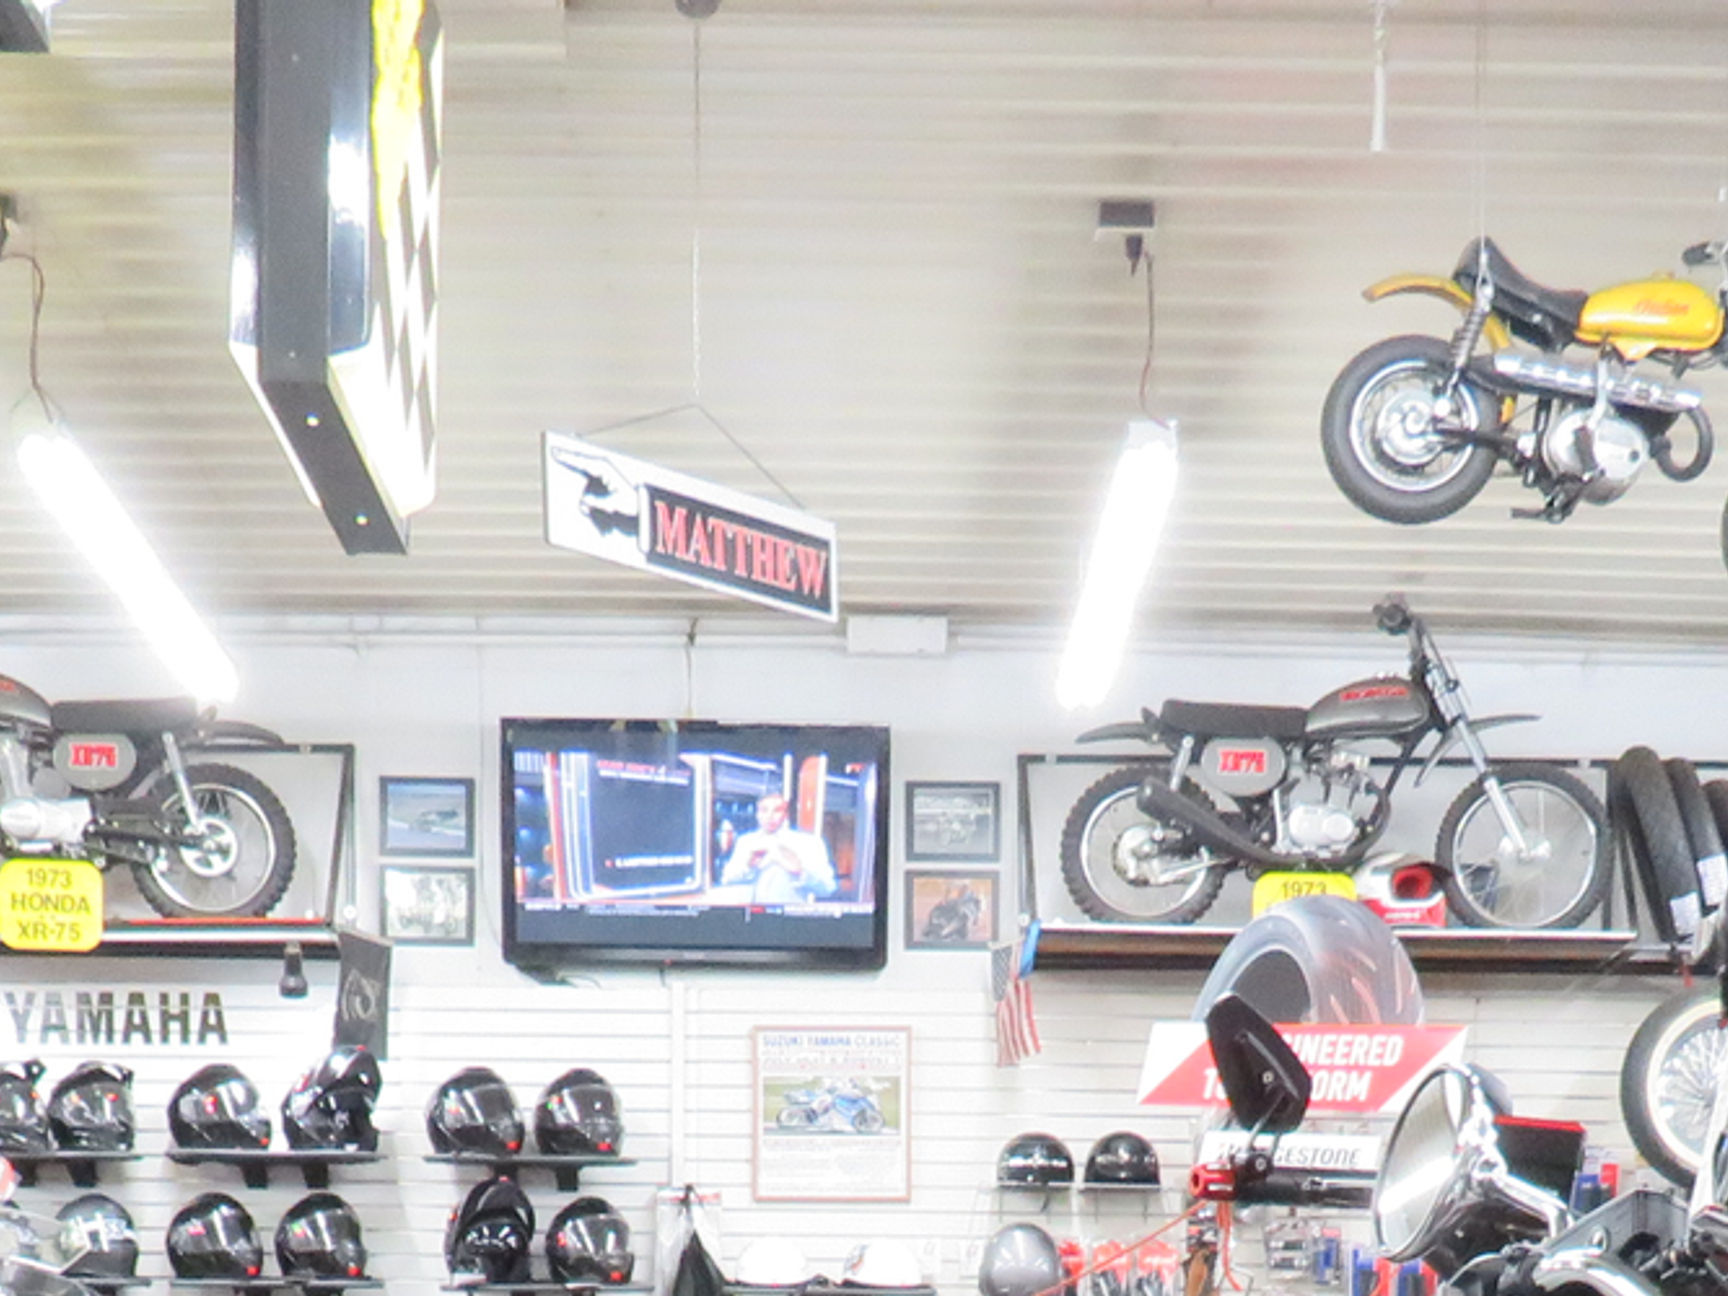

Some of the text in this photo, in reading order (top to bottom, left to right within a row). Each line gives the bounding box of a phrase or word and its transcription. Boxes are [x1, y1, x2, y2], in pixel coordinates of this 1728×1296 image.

[654, 500, 828, 600] MATTHEW
[25, 868, 74, 889] 1973
[10, 892, 92, 914] HONDA
[16, 921, 82, 943] XR-75
[3, 991, 229, 1045] YAMAHA
[1281, 1033, 1404, 1067] INEERED
